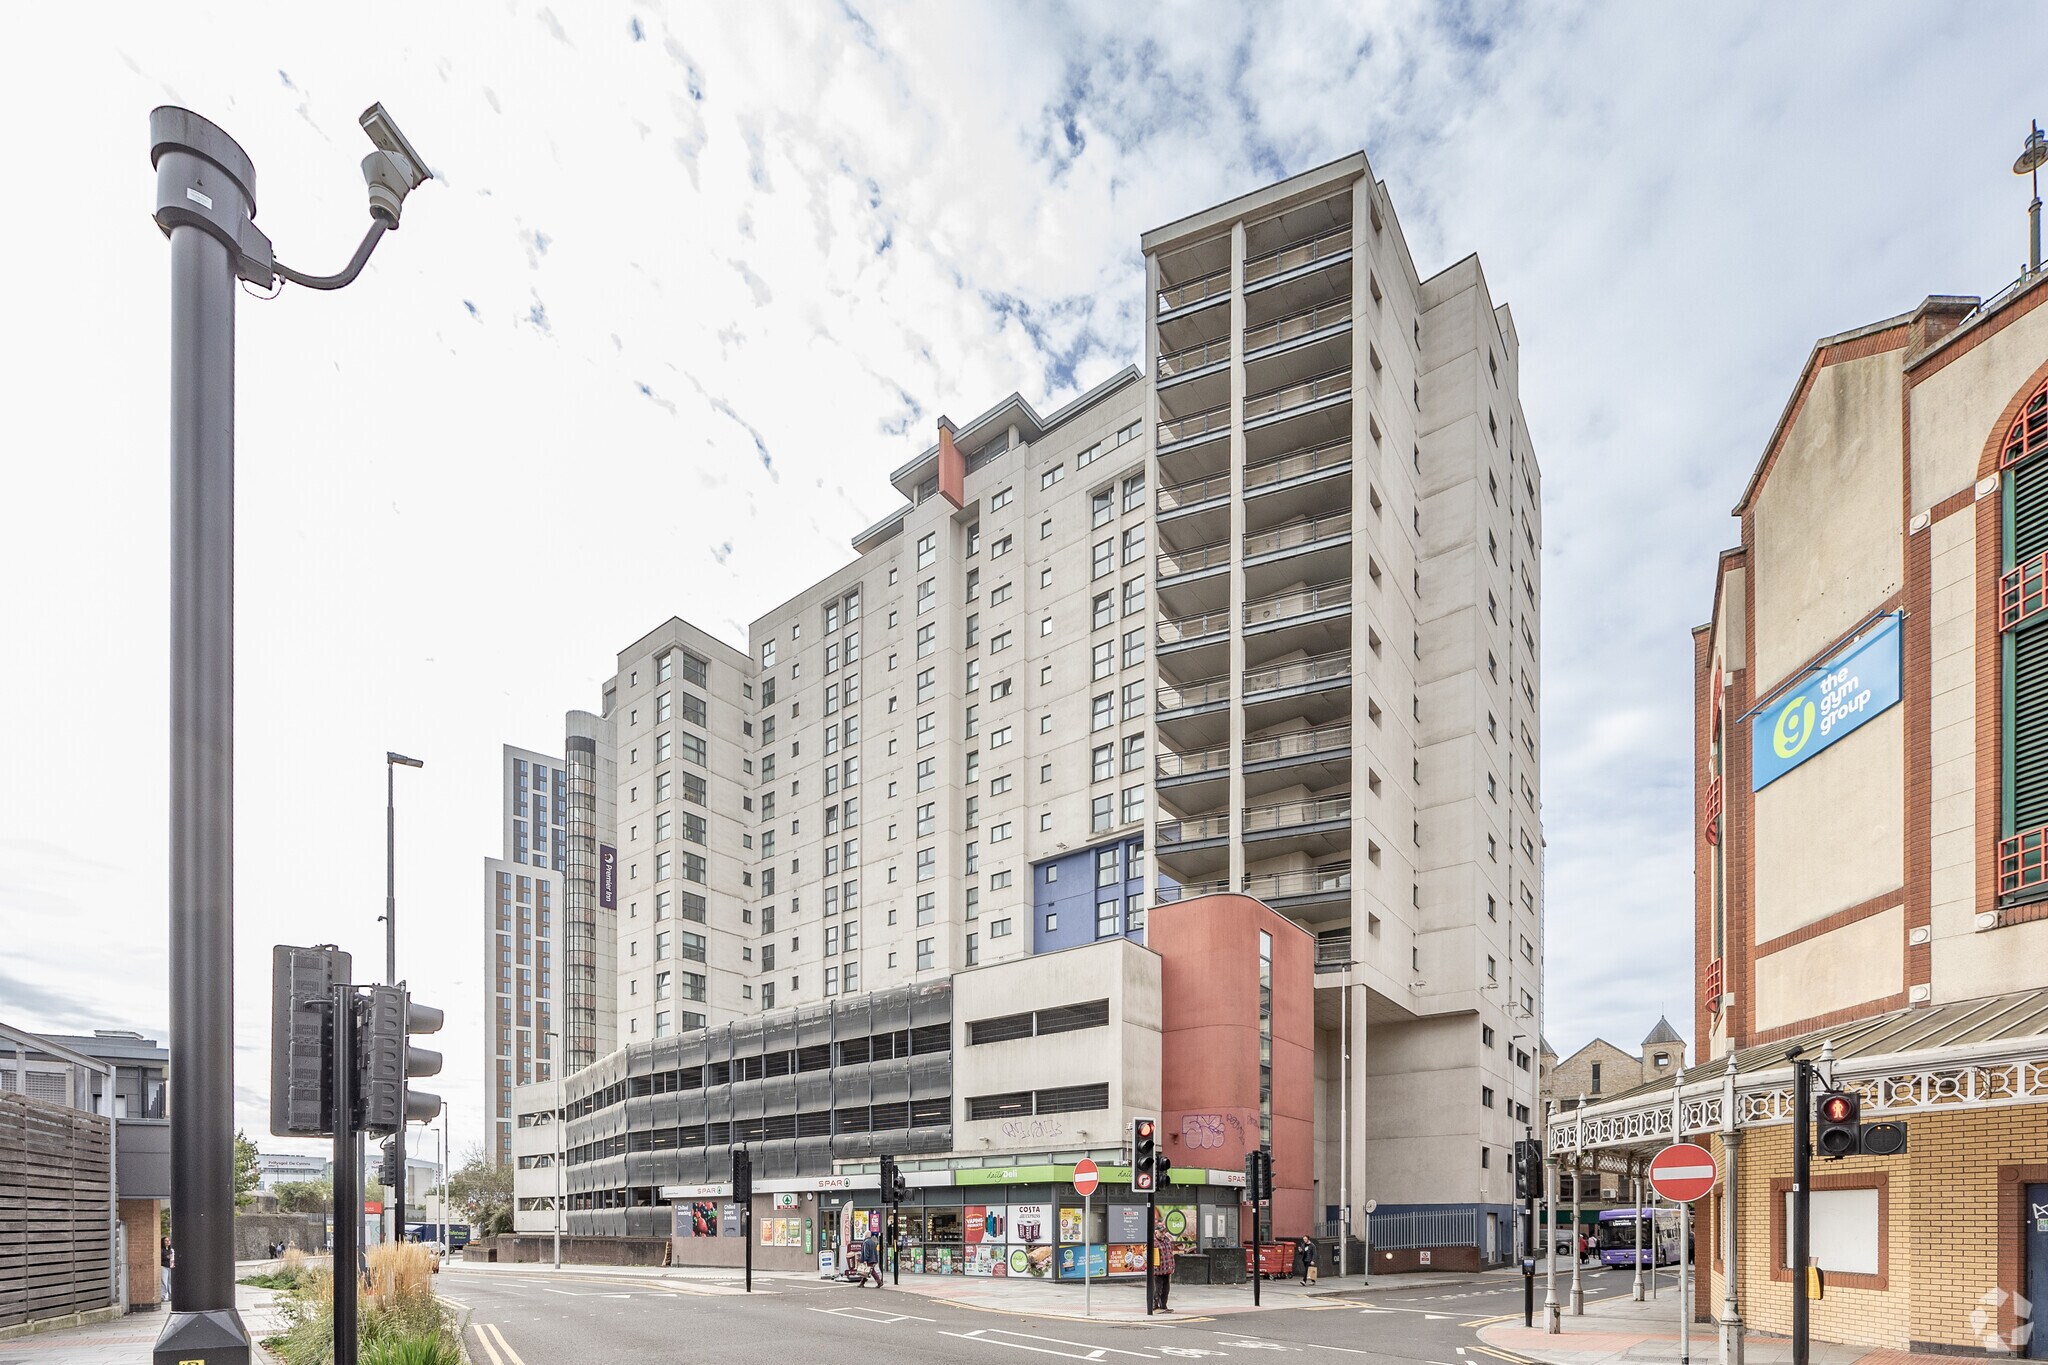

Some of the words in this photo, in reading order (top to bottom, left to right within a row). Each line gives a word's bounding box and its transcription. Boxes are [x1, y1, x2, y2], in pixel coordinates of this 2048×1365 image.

[1820, 667, 1849, 694] the
[1820, 676, 1859, 716] gym
[1820, 689, 1871, 736] group
[605, 864, 613, 891] Premier
[818, 1179, 843, 1188] SPAR
[986, 1171, 1004, 1183] daily
[1003, 1169, 1018, 1178] Deli
[697, 1187, 716, 1195] SPAR
[1019, 1206, 1041, 1214] COSTA
